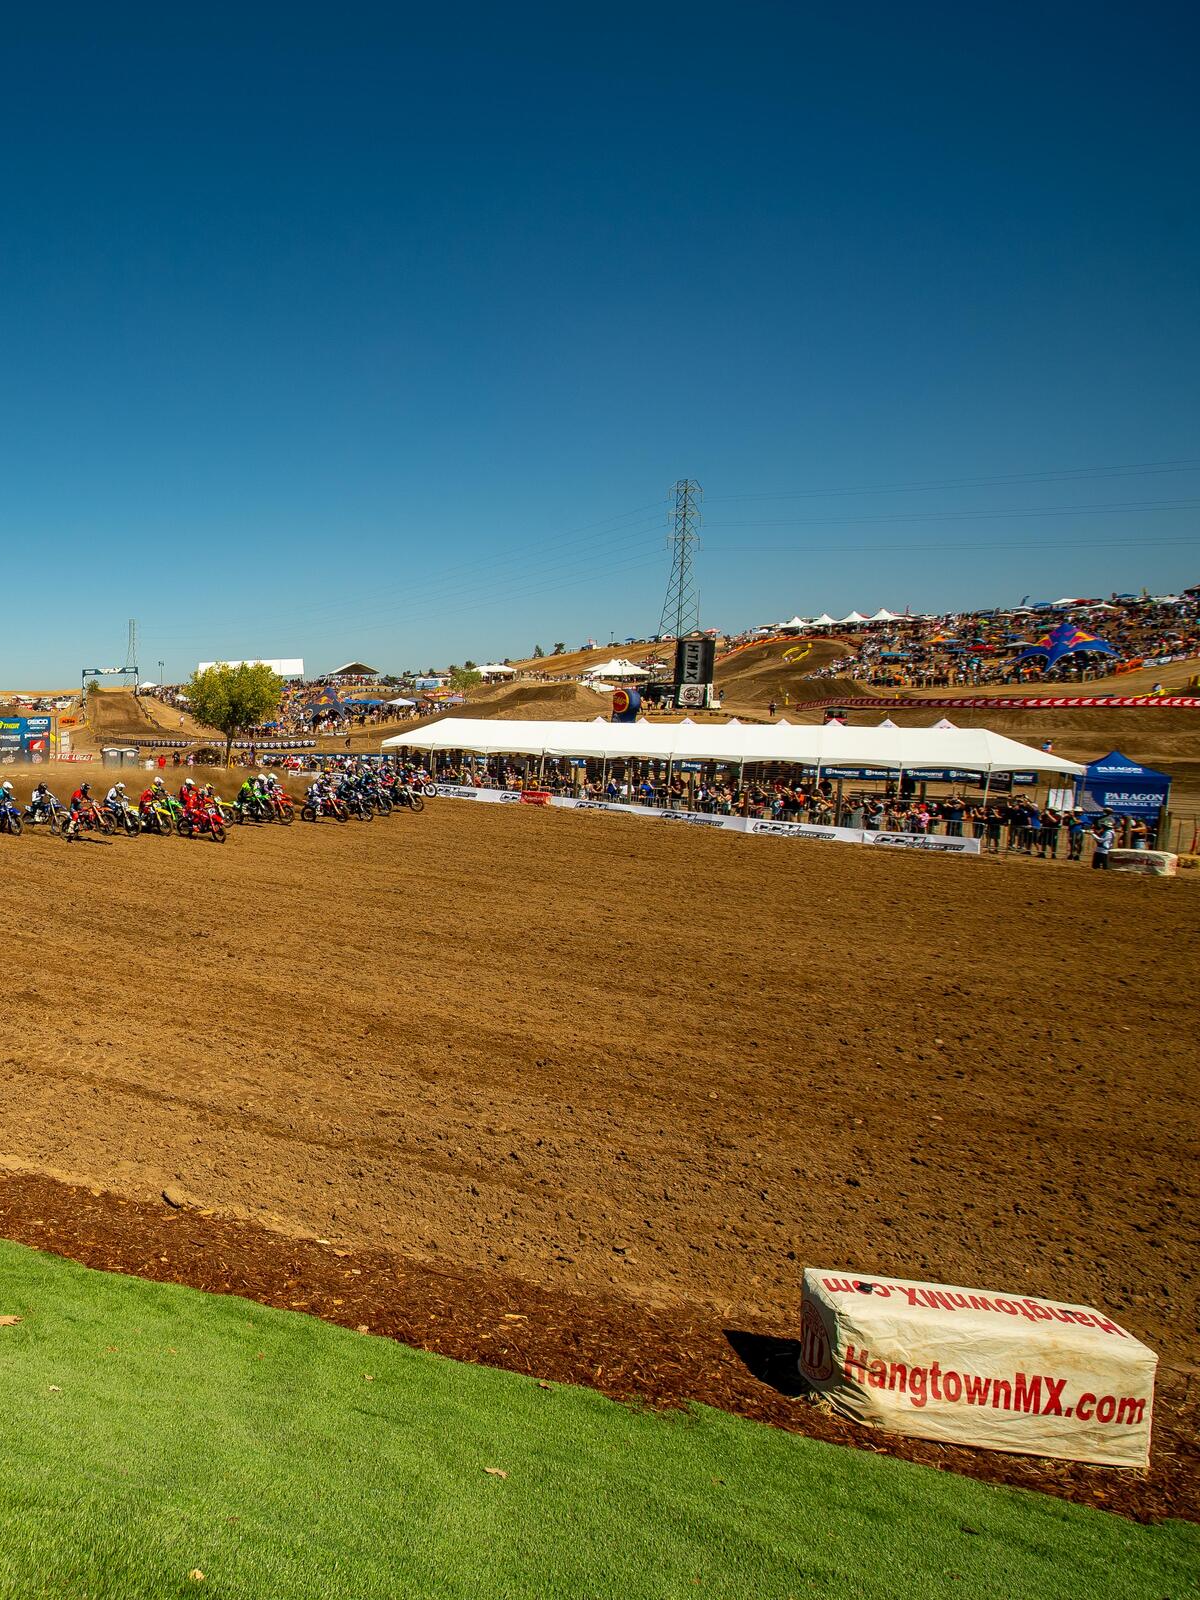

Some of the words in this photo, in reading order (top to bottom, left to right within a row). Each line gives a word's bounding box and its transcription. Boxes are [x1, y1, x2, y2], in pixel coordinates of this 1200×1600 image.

[686, 644, 699, 679] HTMX
[1104, 792, 1165, 801] PARAGON
[842, 1346, 1146, 1425] HangtownMX.com
